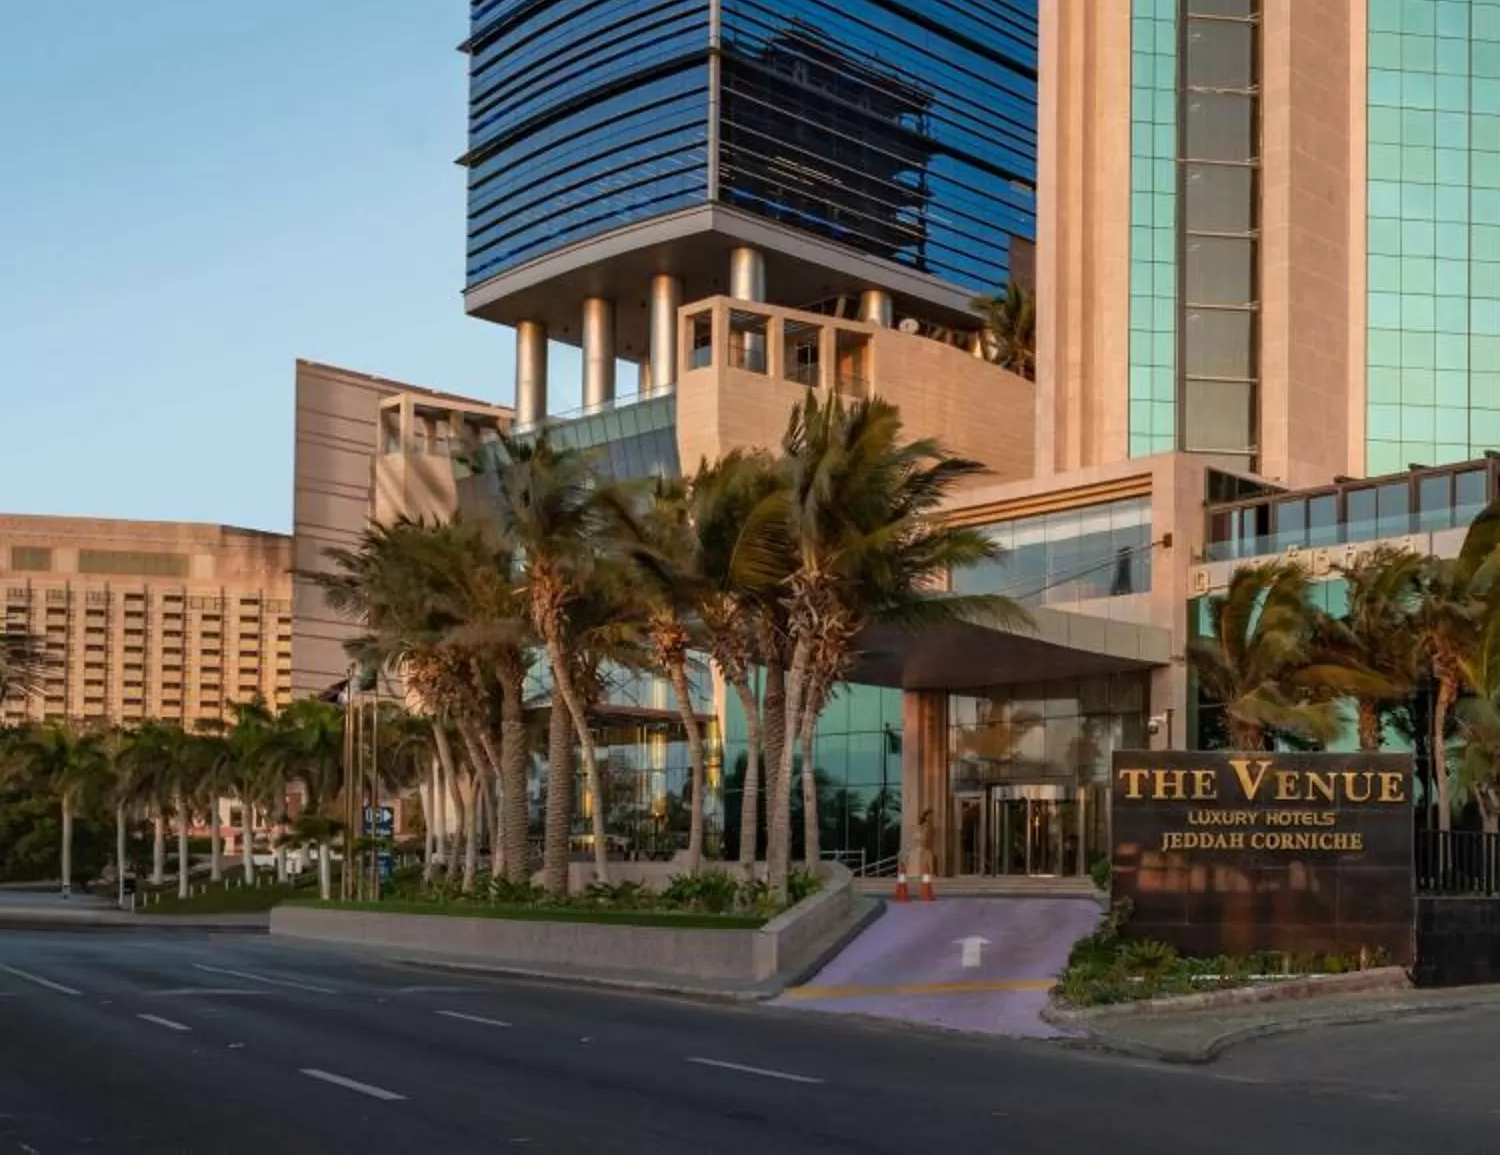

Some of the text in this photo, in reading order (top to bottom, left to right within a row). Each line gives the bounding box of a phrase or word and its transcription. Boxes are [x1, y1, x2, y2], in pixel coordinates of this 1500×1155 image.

[1119, 759, 1406, 802] THE VENUE
[1188, 809, 1337, 827] LUXURY HOTELS
[1161, 832, 1363, 852] JEDDAH CORNICHE
